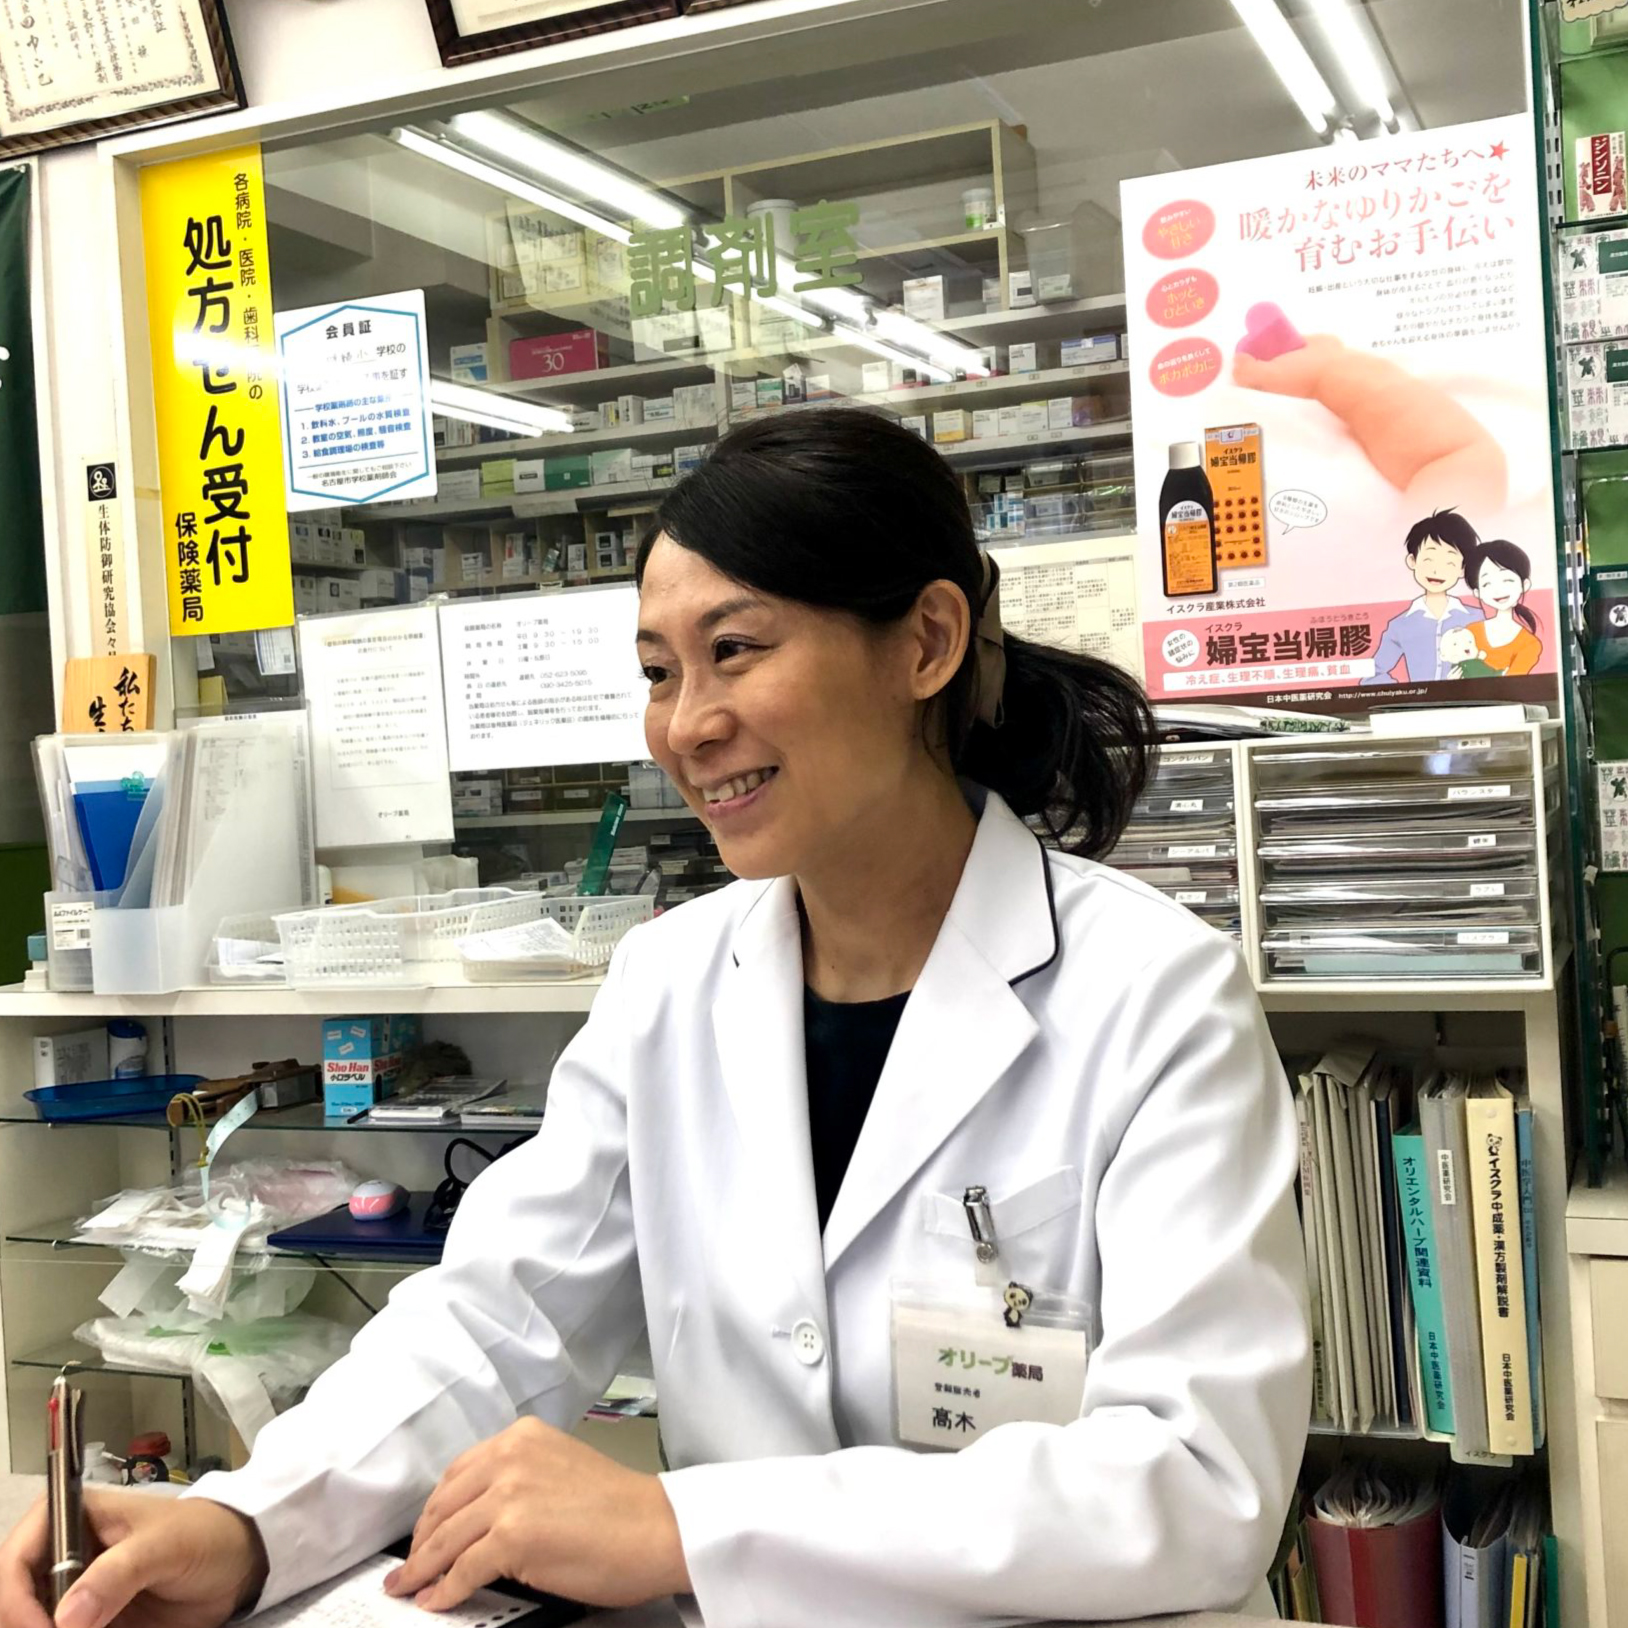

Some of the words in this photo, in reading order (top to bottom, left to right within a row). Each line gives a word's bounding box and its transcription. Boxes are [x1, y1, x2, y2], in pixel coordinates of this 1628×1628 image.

[1304, 147, 1485, 190] 未来のママたちへ
[1238, 171, 1511, 242] 暖かなゆりかごを
[1156, 217, 1200, 239] やさしい
[1294, 214, 1515, 273] 育むお手伝い
[627, 199, 864, 316] 調剤室
[233, 172, 263, 400] 各病院・医院・歯科院の
[1162, 297, 1205, 320] ひといき
[326, 320, 372, 340] 会員証
[376, 343, 406, 358] 学校の
[541, 352, 566, 373] 30
[183, 214, 252, 586] 処方せん受付
[321, 471, 398, 488] 名古屋市学校薬剤師会
[175, 511, 204, 622] 保険薬局
[1166, 597, 1266, 615] イスクラ産業株式会社
[1205, 621, 1243, 634] イスクラ
[1205, 624, 1372, 667] 婦宝当帰膠
[1185, 663, 1351, 687] 冷え症、生理不順、生理痛、貧血
[88, 695, 107, 733] 生
[1266, 691, 1333, 704] 日本中医薬研究会
[327, 1062, 347, 1073] Sho
[348, 1062, 370, 1073] Han
[1402, 1156, 1433, 1289] オリエンタルハーブ関連資料
[1488, 1157, 1510, 1318] イスクラ中成薬・漢方製剤解説書
[937, 1347, 1044, 1382] オリーブ薬局
[1428, 1331, 1446, 1410] 日本中医薬研究会
[934, 1381, 981, 1399] 登録販売者
[1501, 1352, 1515, 1422] 日本中医薬研究会
